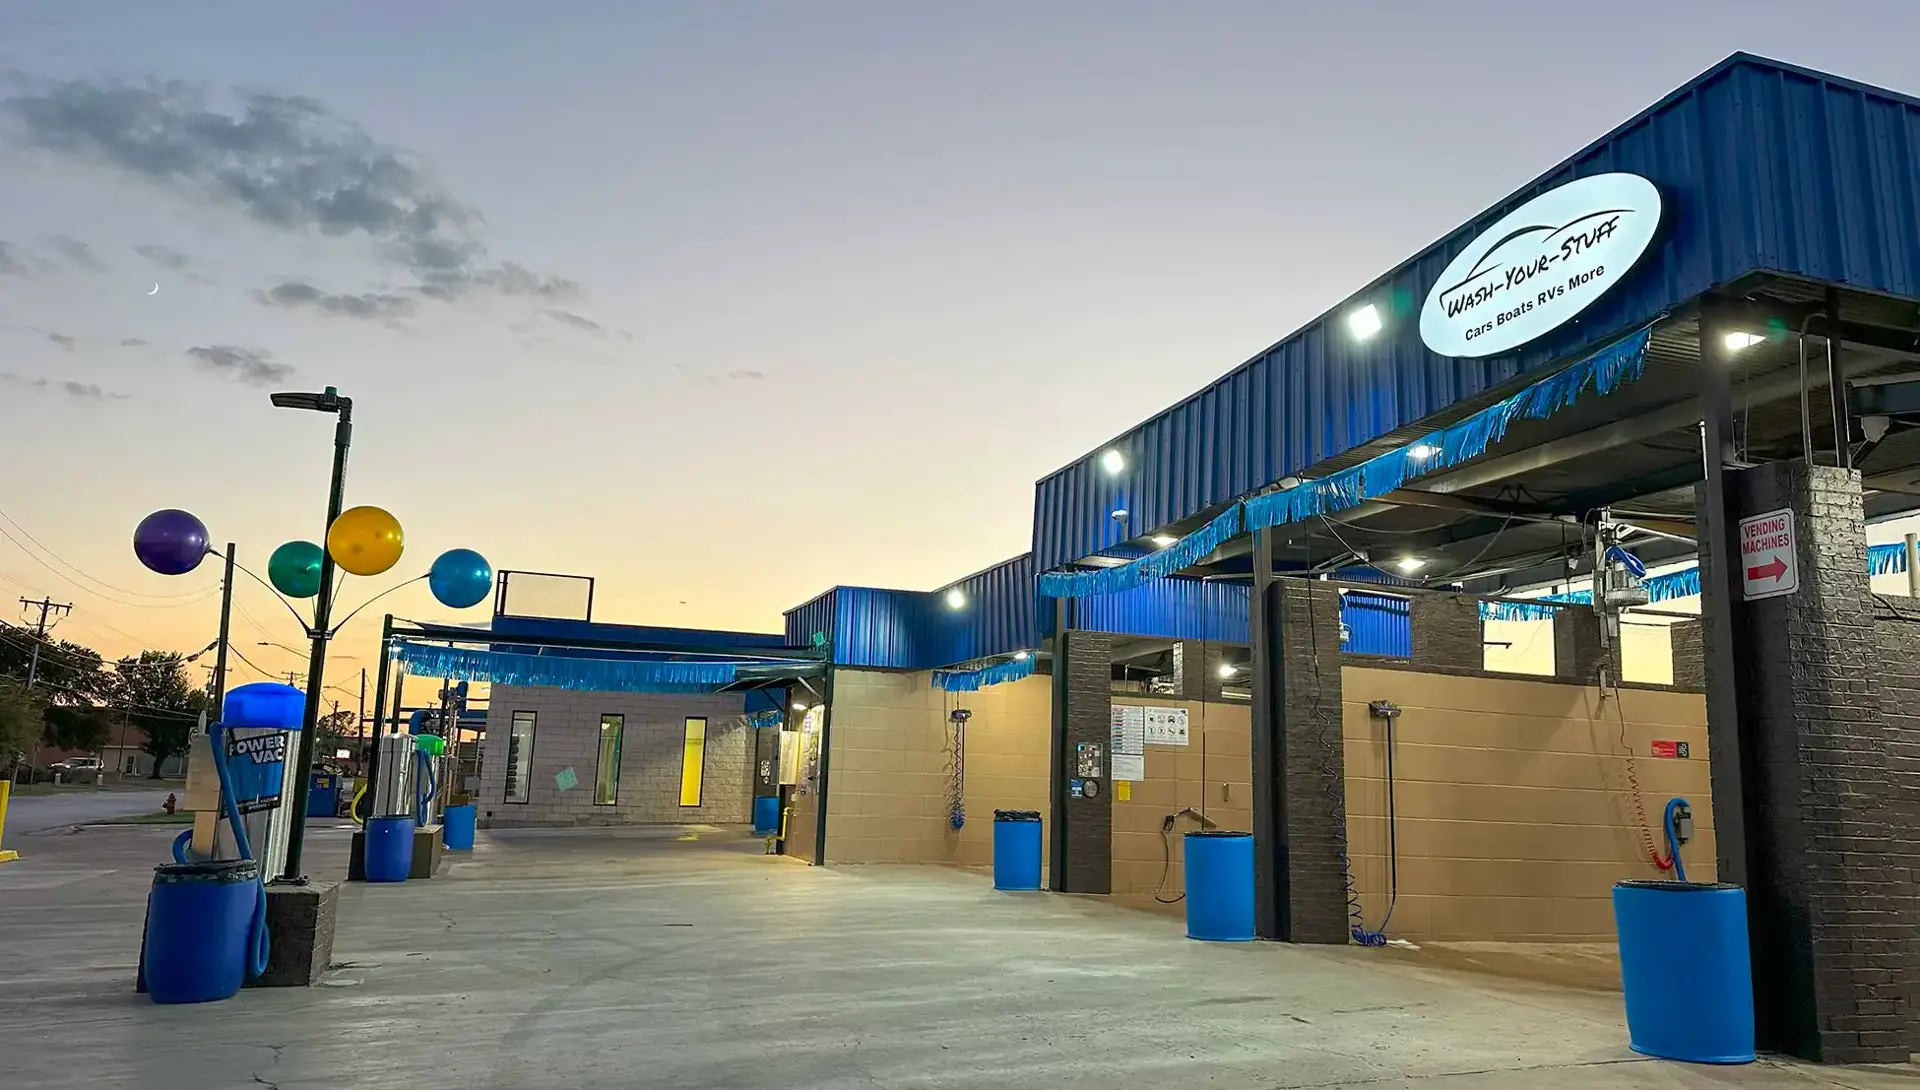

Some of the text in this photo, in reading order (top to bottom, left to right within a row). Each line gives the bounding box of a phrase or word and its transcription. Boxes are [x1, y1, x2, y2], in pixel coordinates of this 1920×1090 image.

[1465, 265, 1605, 341] Cars Boats RVs More
[1744, 518, 1785, 539] VENDING
[1742, 533, 1789, 555] MACHINES
[229, 735, 285, 756] POWER
[251, 747, 284, 764] VAC
